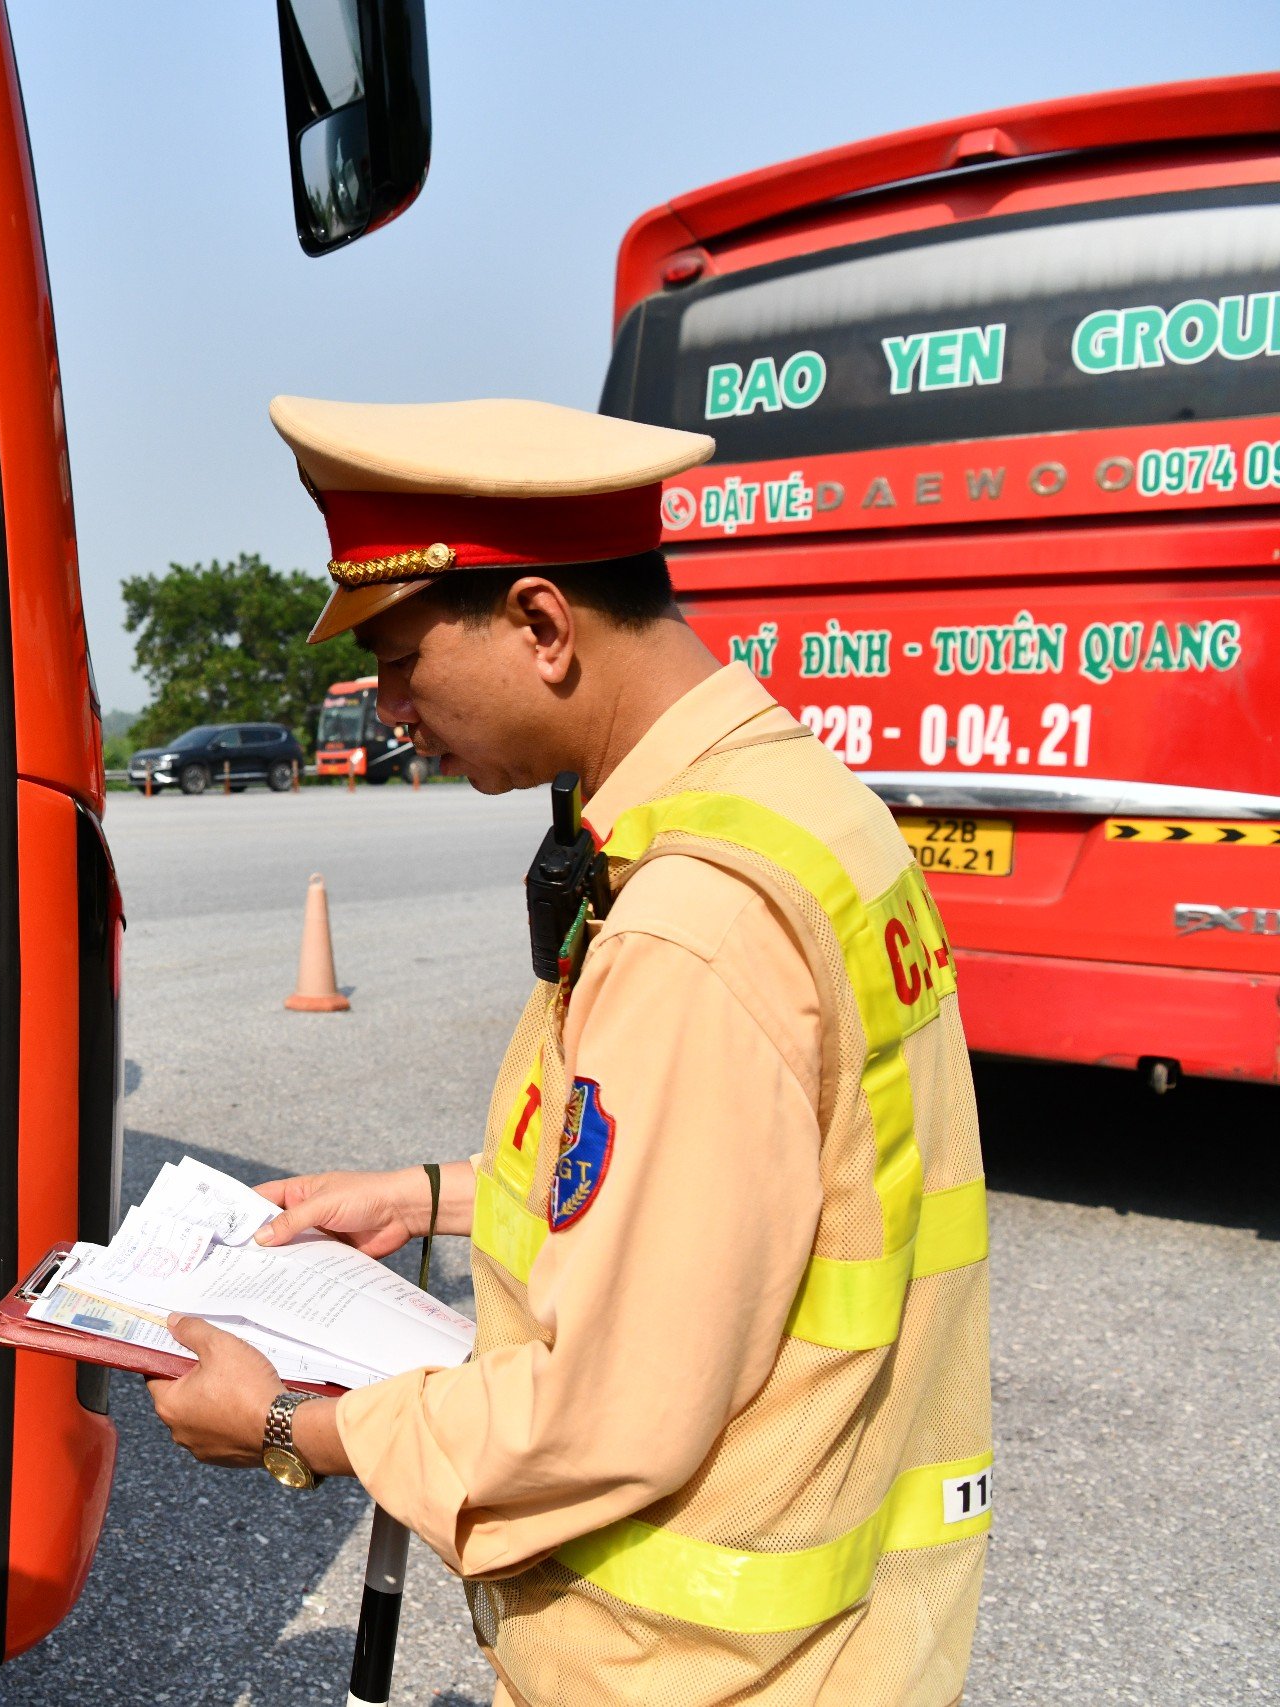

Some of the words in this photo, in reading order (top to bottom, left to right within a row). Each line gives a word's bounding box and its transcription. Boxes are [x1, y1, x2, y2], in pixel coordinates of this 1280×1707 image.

[706, 351, 825, 419] BAO
[884, 325, 1005, 394] YEN
[817, 458, 1134, 512] DAEWOO
[1137, 444, 1236, 497] 0974
[800, 618, 892, 678] ĐÌNH
[933, 610, 1067, 677] TUYÊN
[1080, 619, 1241, 684] QUANG
[926, 819, 977, 843] 22B
